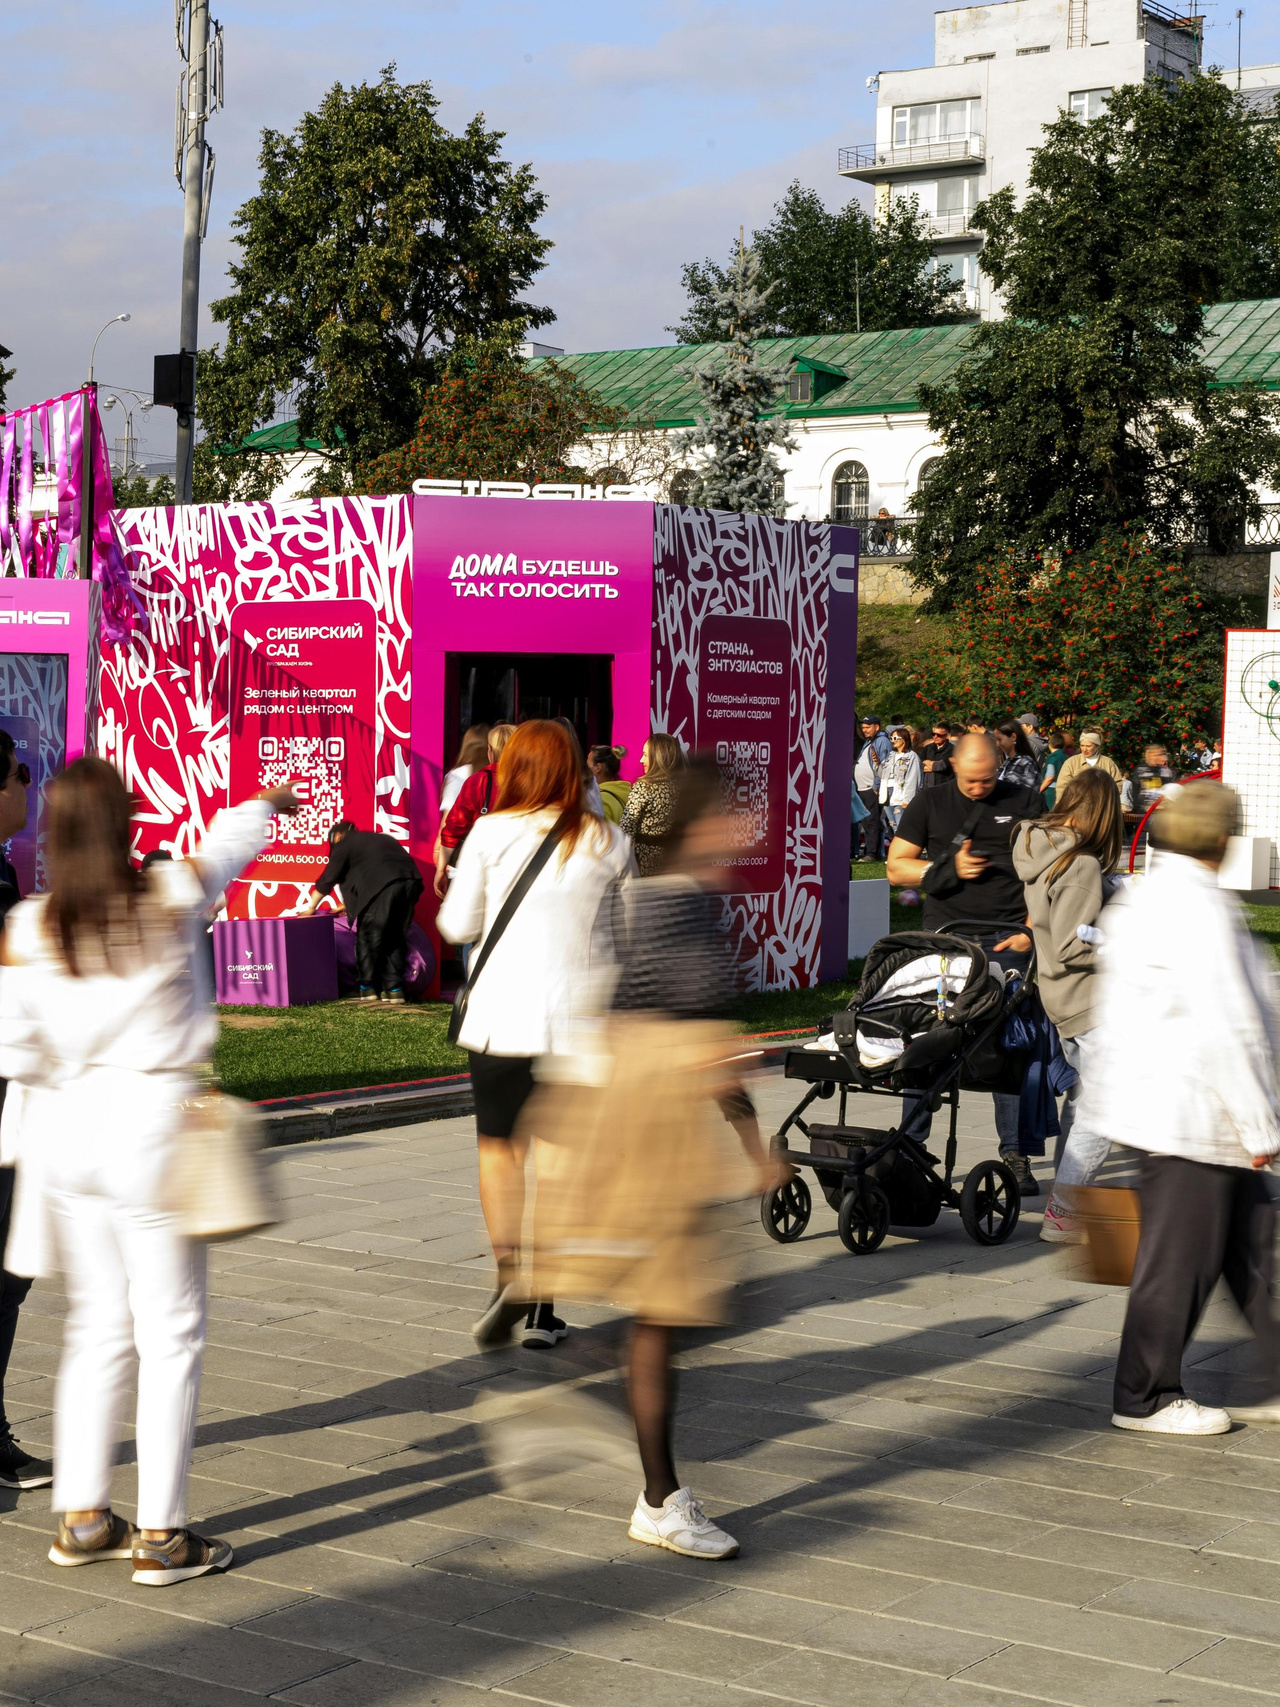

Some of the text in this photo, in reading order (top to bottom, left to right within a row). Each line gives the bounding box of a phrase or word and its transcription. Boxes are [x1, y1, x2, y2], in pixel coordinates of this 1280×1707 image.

[448, 553, 619, 580] ДОМА БУДЕШЬ
[451, 582, 619, 599] ТАК ГОЛОСИТЬ
[266, 622, 363, 640] СИБИРСКИЙ
[266, 643, 300, 658] САД
[707, 658, 783, 675] ЭНТУЗИАСТОВ
[243, 686, 357, 700] Зеленый квартал
[707, 692, 780, 707] Камерный квартал
[243, 704, 354, 716] рядом с центром
[706, 708, 772, 721] с детским садом
[256, 853, 330, 865] СКИДКА 500 00
[751, 857, 763, 865] 000
[227, 962, 274, 972] СИБИРСКИЙ
[242, 972, 260, 980] САД
